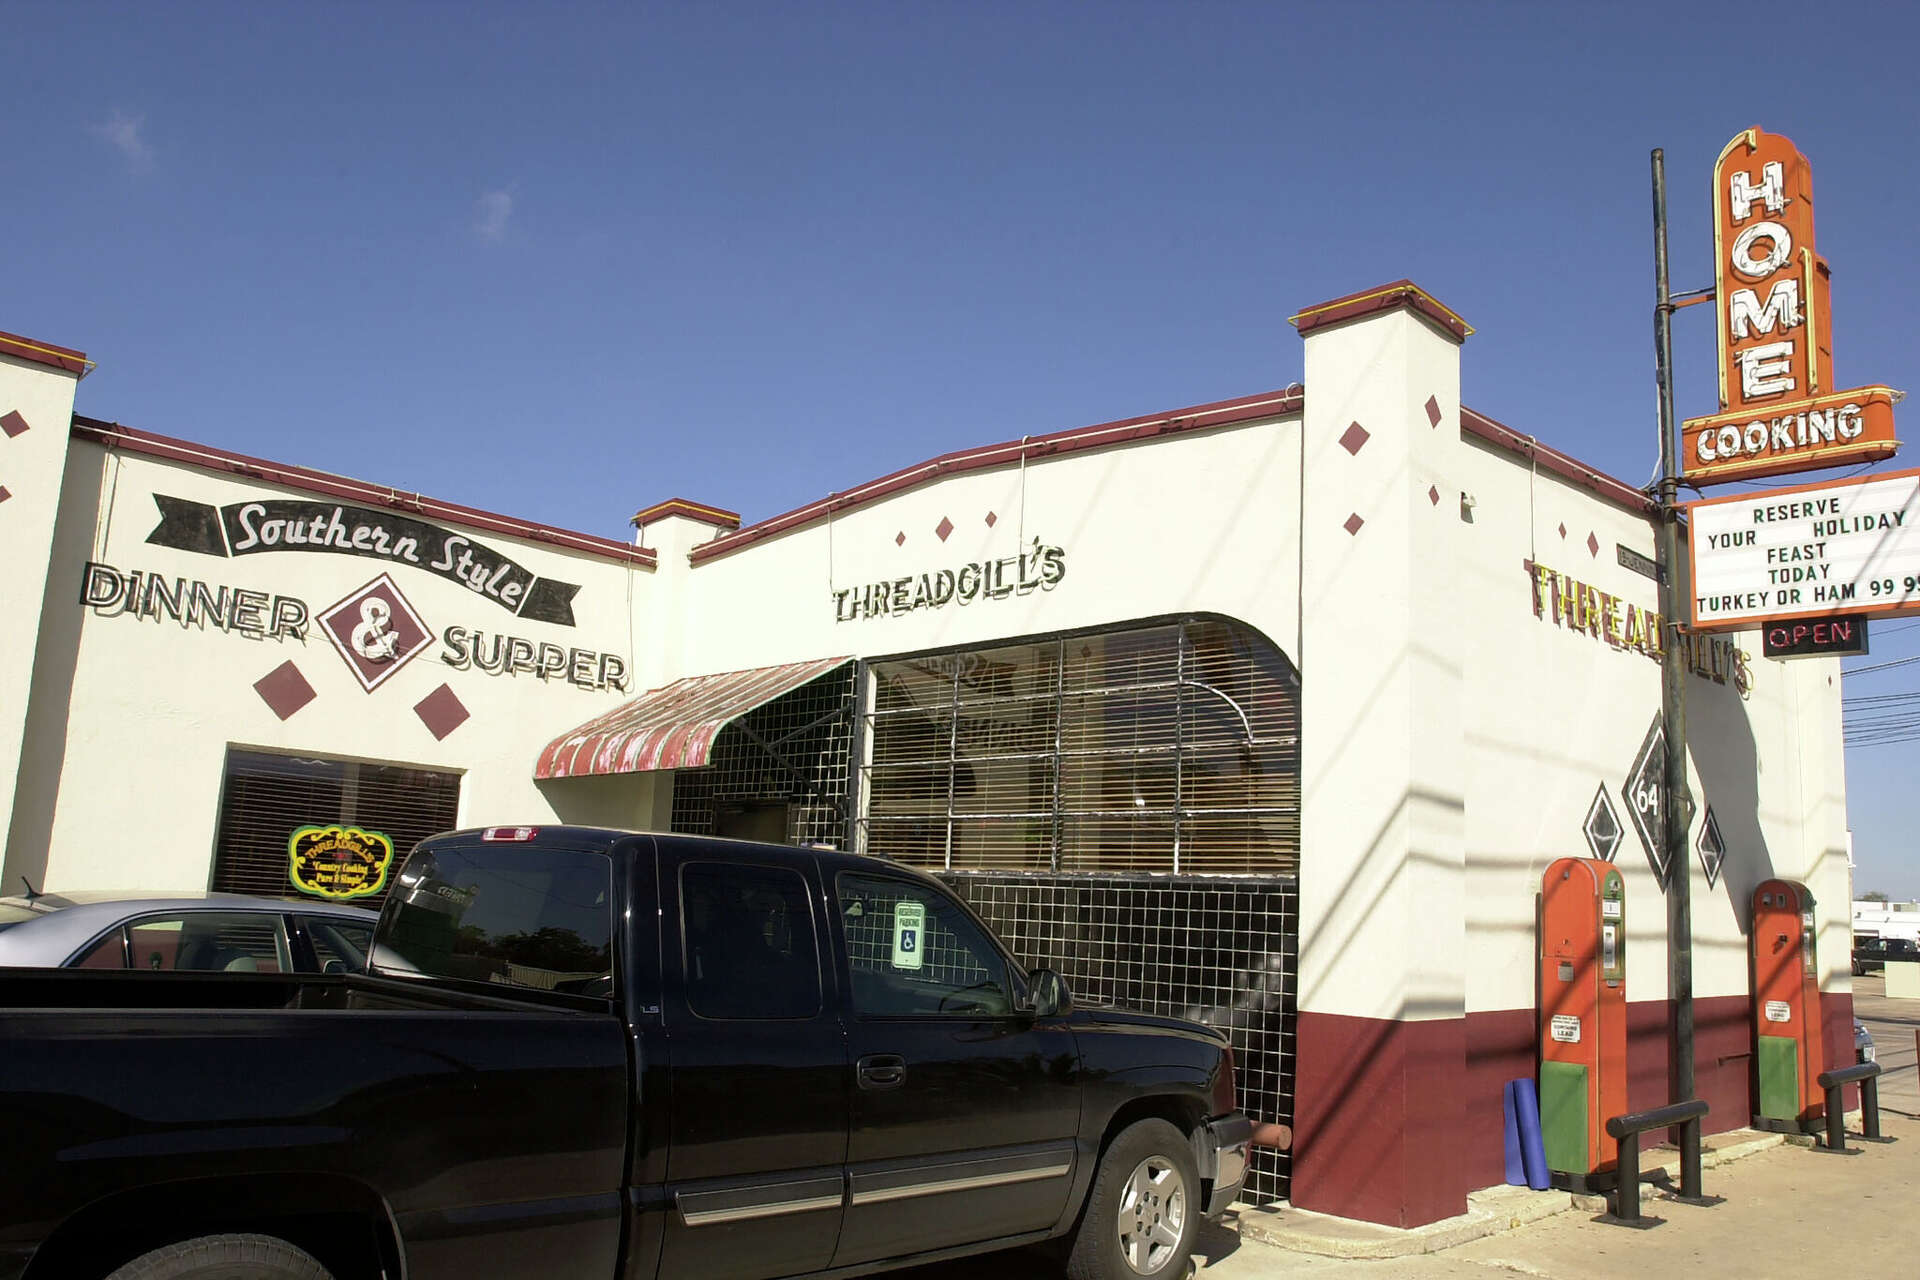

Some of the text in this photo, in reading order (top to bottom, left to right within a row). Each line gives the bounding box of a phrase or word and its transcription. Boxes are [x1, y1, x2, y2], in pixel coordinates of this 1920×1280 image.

[1730, 161, 1805, 399] HOME
[1697, 403, 1864, 461] COOKING
[1708, 510, 1906, 550] YOUR HOLIDAY
[1753, 497, 1841, 524] RESERVE
[235, 503, 524, 607] Southern Style
[1767, 542, 1827, 564] FEAST
[832, 535, 1066, 624] THREADGILL'S
[1697, 575, 1920, 613] TURKEY OR HAM 99 9
[1768, 563, 1831, 585] TODAY
[79, 561, 628, 695] DINNER & SUPPER
[1769, 620, 1852, 648] OPEN
